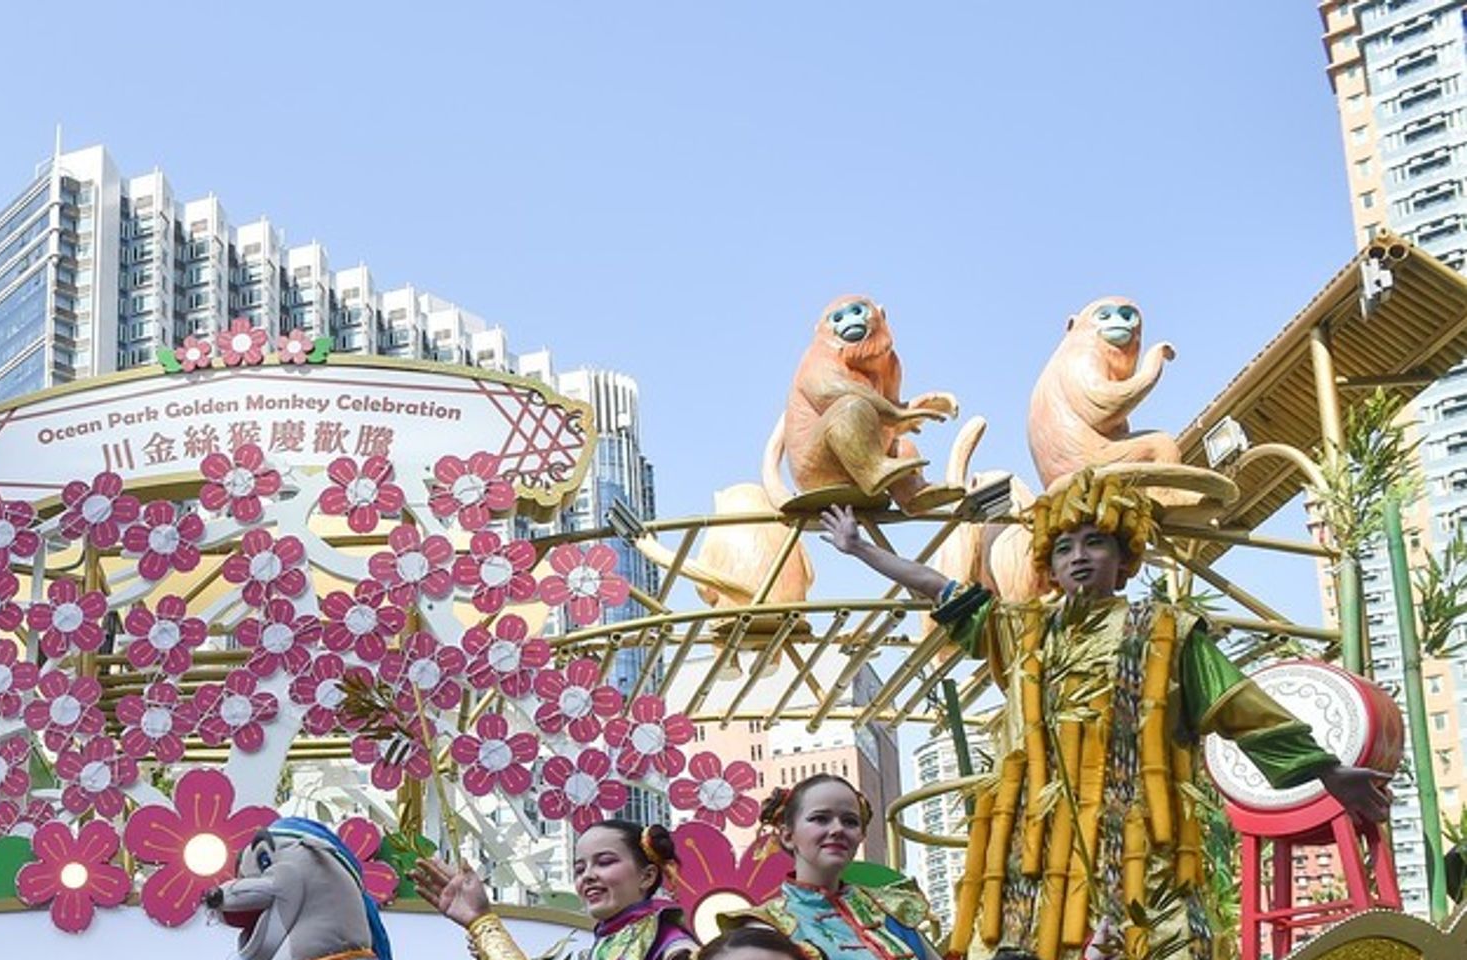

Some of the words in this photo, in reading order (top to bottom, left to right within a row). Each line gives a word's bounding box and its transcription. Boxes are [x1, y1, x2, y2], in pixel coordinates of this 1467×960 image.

[37, 418, 103, 445] Ocean
[107, 406, 159, 429] Park
[164, 398, 239, 419] Golden
[245, 393, 330, 413] Monkey
[336, 394, 462, 421] Celebration
